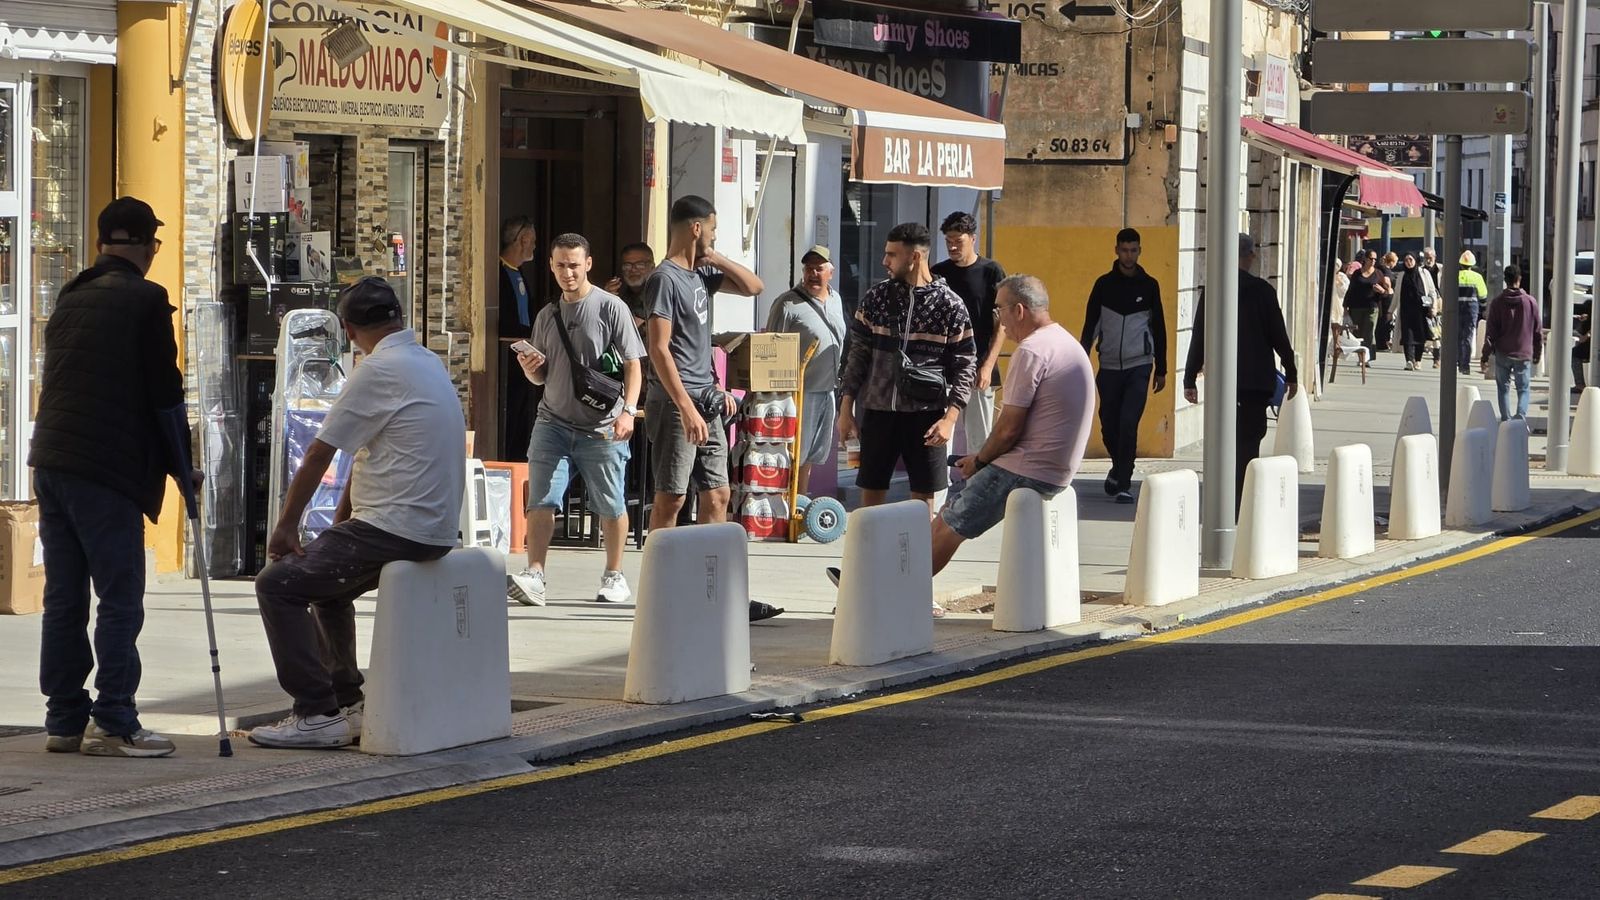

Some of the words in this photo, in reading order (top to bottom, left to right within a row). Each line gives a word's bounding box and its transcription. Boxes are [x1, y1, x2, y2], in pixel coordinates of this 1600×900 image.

[270, 0, 423, 35] COMCIAL
[873, 14, 917, 52] Jimy
[924, 20, 970, 49] Shoes
[299, 38, 423, 93] MALDONADO
[884, 137, 910, 175] BAR
[917, 140, 934, 177] LA
[937, 142, 973, 179] PERLA
[1050, 138, 1068, 153] 50
[1071, 138, 1088, 153] 83
[1092, 139, 1110, 153] 64
[581, 394, 606, 410] FILA
